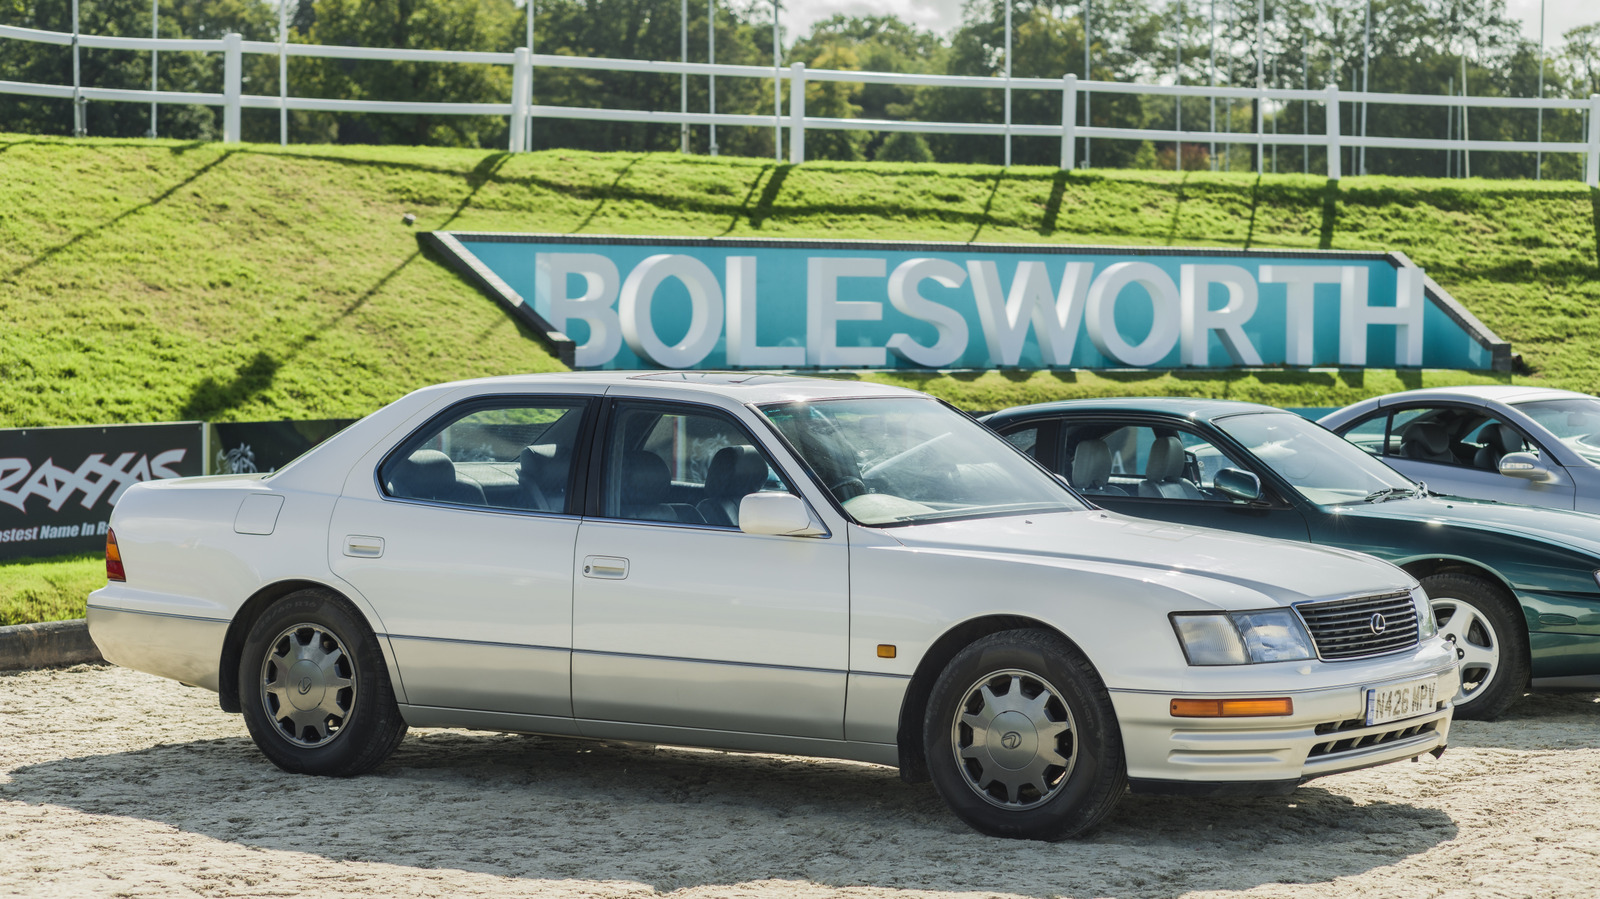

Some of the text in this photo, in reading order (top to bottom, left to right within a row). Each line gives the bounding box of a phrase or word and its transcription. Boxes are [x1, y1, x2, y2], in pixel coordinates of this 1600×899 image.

[535, 252, 1424, 368] BOLESWORTH
[40, 524, 79, 538] Name
[81, 522, 95, 536] In
[1376, 682, 1436, 719] N426 MPV
